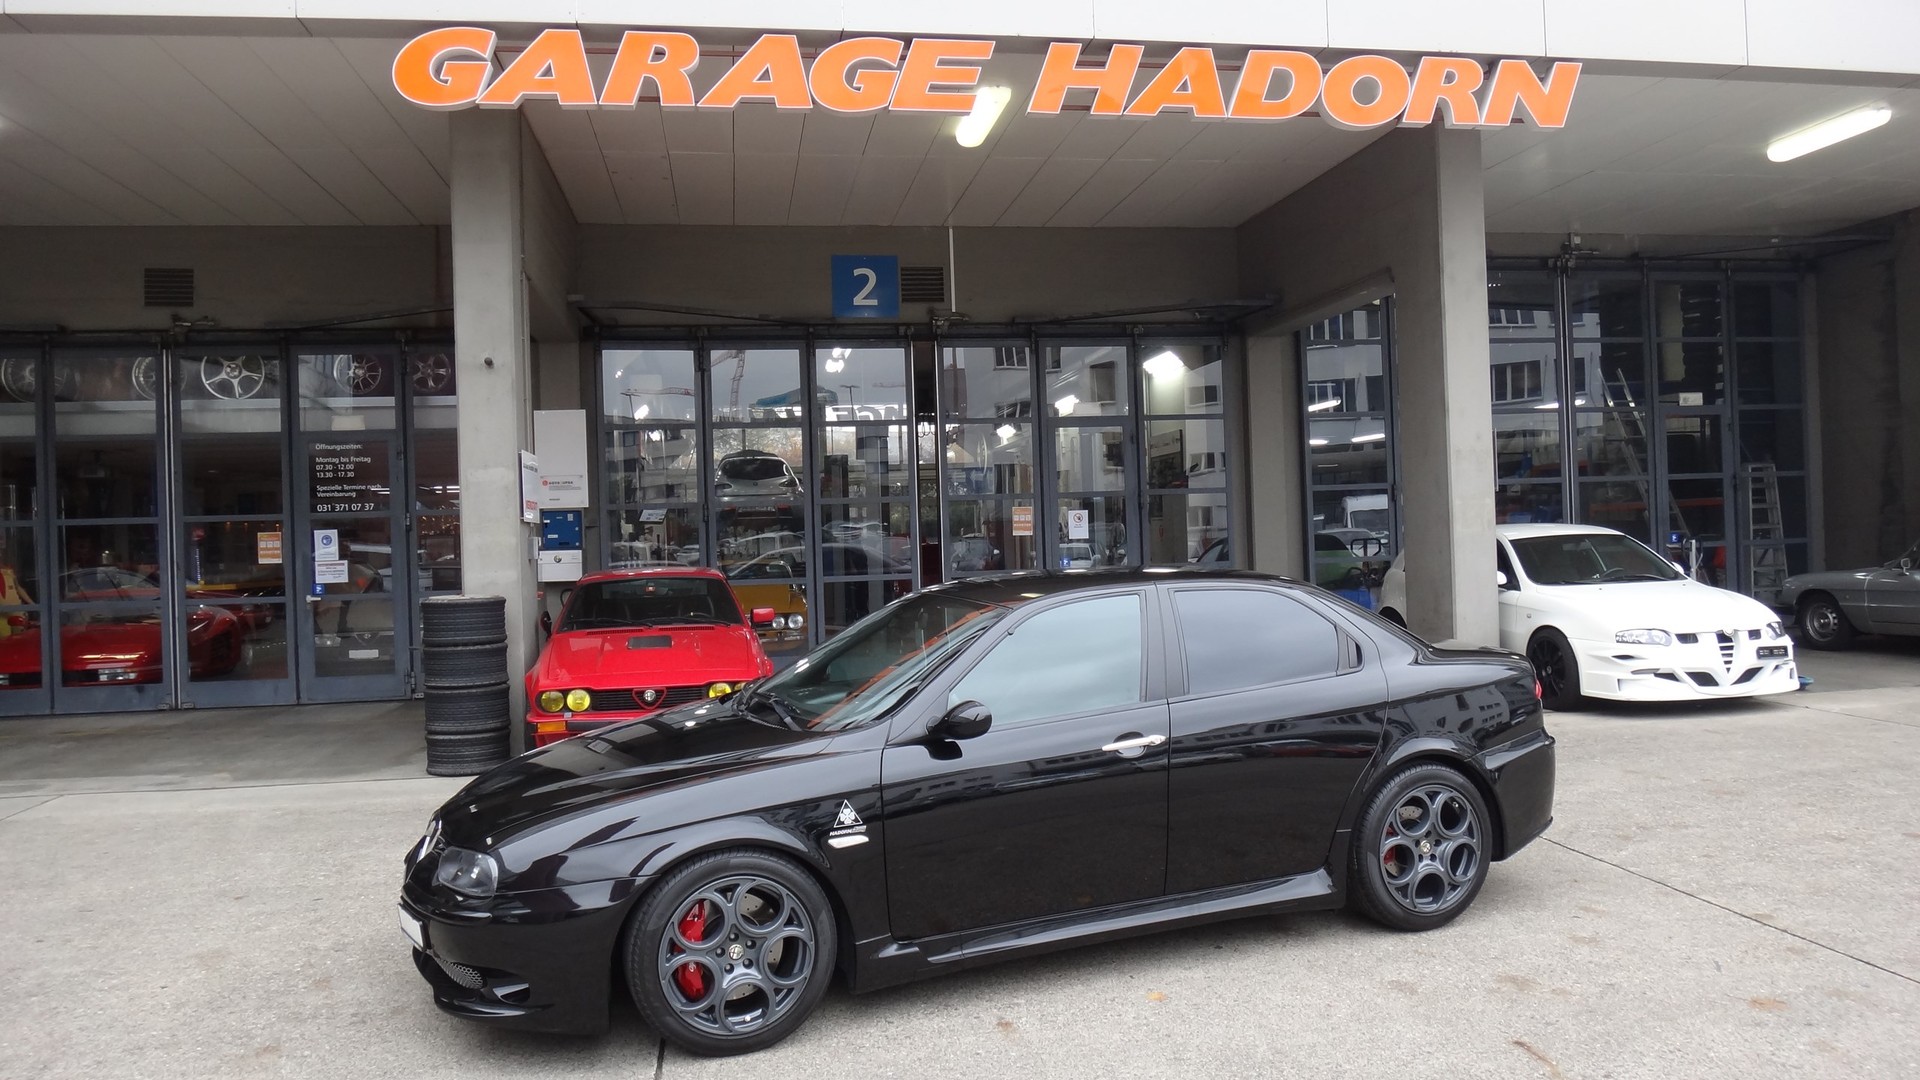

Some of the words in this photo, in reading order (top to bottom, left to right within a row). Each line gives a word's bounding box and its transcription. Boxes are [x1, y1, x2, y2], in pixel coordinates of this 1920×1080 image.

[391, 26, 995, 113] GARAGE
[1027, 41, 1583, 128] HADORN
[853, 267, 878, 306] 2
[316, 484, 342, 492] Spezielle
[316, 504, 332, 512] 031
[334, 503, 349, 511] 371
[351, 503, 362, 511] 07
[364, 503, 375, 511] 37
